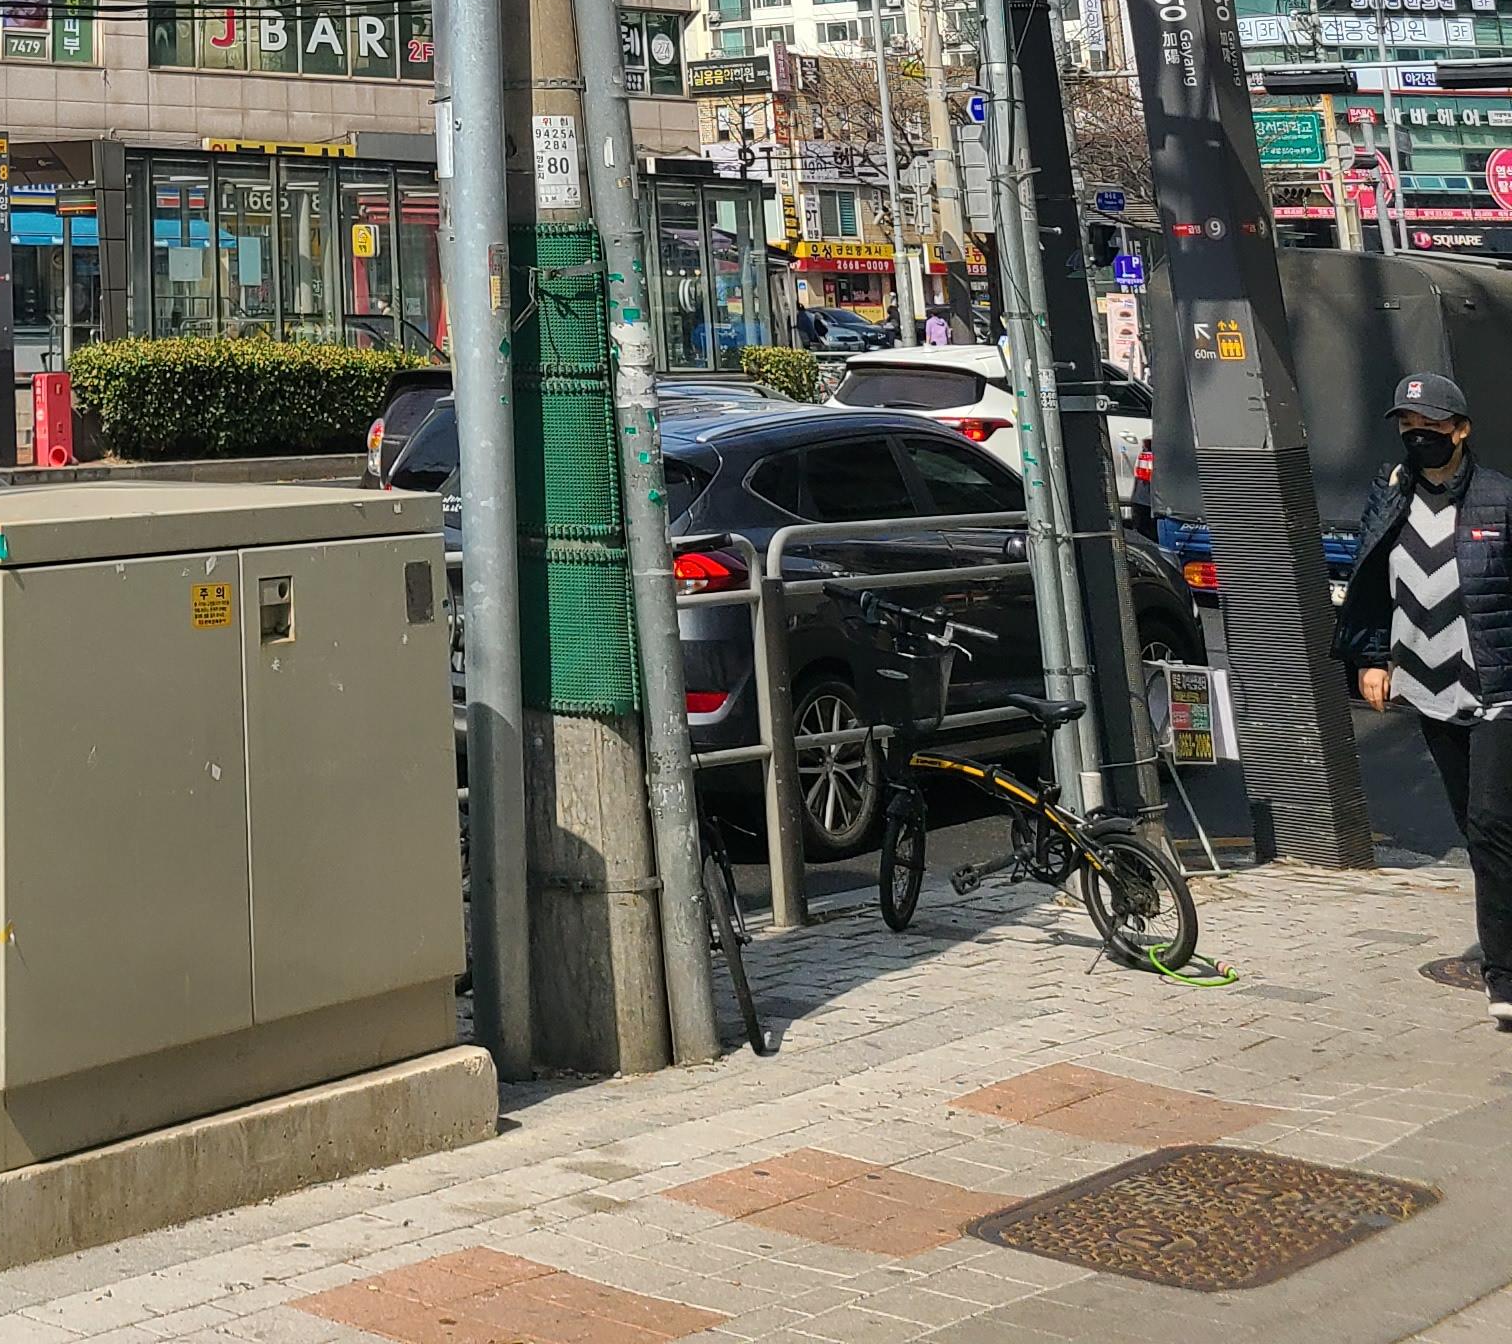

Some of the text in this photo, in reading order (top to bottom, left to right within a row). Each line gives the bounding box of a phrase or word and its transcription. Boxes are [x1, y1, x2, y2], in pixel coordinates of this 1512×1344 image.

[260, 10, 389, 59] BAR
[1260, 22, 1276, 37] 3F
[1452, 23, 1469, 38] 3F
[10, 39, 40, 53] 7479
[408, 40, 434, 63] 2F
[1162, 31, 1180, 65] 加陽
[1179, 29, 1197, 87] Gayang
[535, 129, 575, 139] 9425A
[544, 141, 567, 150] 284
[0, 164, 8, 181] 8
[548, 157, 570, 174] 80
[1210, 220, 1220, 236] 9
[1432, 234, 1483, 248] SQUARE
[811, 244, 832, 261] 우성
[1132, 257, 1140, 267] P
[1194, 348, 1217, 359] 60m
[200, 586, 225, 600] 주의
